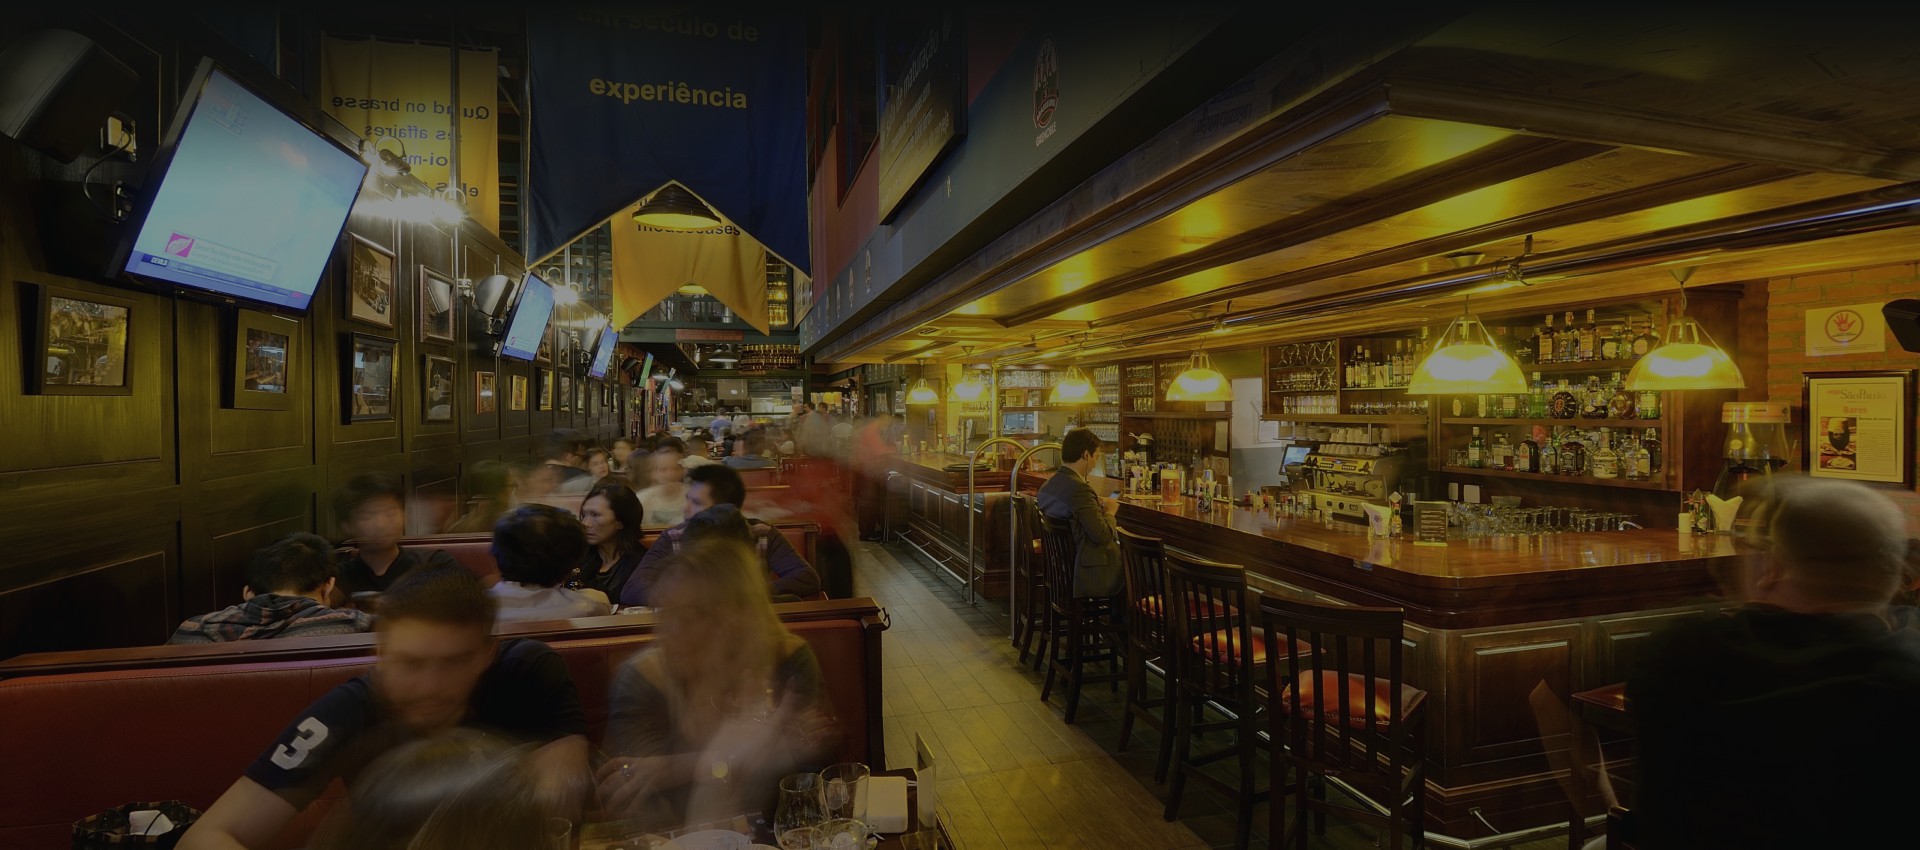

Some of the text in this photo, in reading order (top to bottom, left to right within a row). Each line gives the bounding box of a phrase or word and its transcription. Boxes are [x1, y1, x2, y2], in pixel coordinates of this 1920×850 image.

[727, 20, 760, 42] de
[588, 77, 748, 110] experiência
[270, 716, 329, 770] 3
